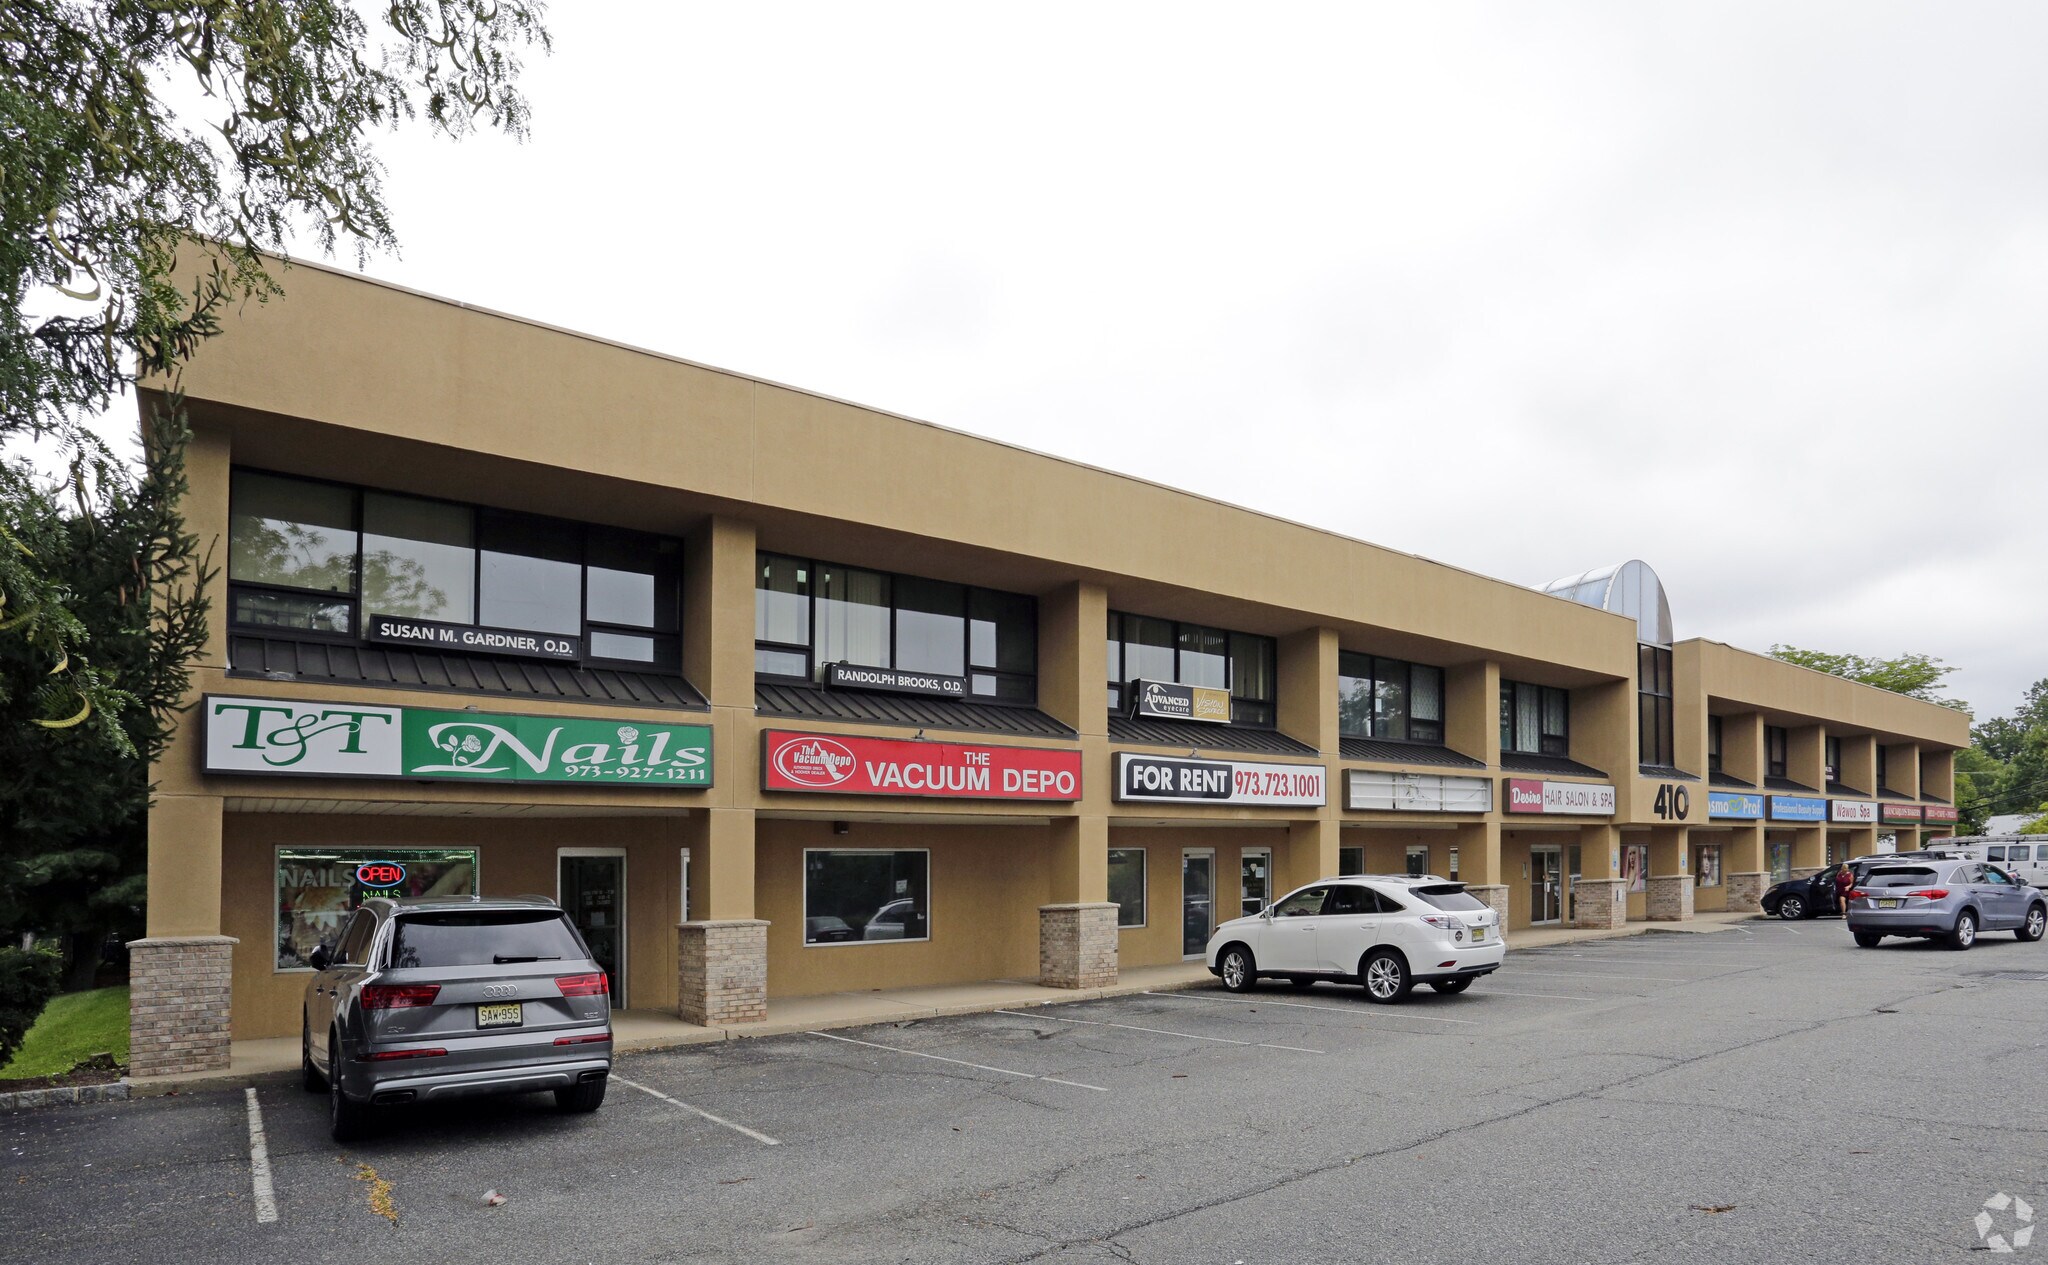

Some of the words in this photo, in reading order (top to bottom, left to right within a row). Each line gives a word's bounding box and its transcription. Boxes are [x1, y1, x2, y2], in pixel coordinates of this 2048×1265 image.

[380, 623, 435, 641] SUSAN
[439, 628, 458, 643] M.
[462, 631, 540, 653] GARDNER,
[543, 639, 573, 654] O.D.
[837, 669, 895, 685] RANDOLPH
[898, 675, 941, 691] BROOKS,
[943, 680, 963, 692] O.D.
[1144, 691, 1190, 708] ADVANCED
[1163, 705, 1190, 713] eyecare
[214, 703, 392, 767] T&T
[411, 722, 706, 774] Nails
[801, 745, 816, 755] The
[793, 752, 828, 765] Vacuum
[829, 753, 852, 767] Depo
[963, 751, 990, 766] THE
[564, 765, 705, 780] 973-927-1211
[865, 761, 990, 792] VACUUM
[1003, 768, 1075, 795] DEPO
[1133, 765, 1174, 791] FOR
[1180, 768, 1228, 793] RENT
[1235, 770, 1320, 797] 973.723.1001
[1512, 787, 1541, 805] Desire
[1544, 788, 1562, 806] HAIR
[1565, 791, 1589, 807] SALON
[1592, 793, 1597, 807] &
[1600, 793, 1613, 808] SPA
[1654, 784, 1689, 820] 410
[1709, 799, 1729, 814] smo
[1743, 797, 1761, 814] Prof
[1860, 804, 1871, 820] Spa
[280, 867, 356, 888] NAILS
[359, 866, 400, 881] OPEN
